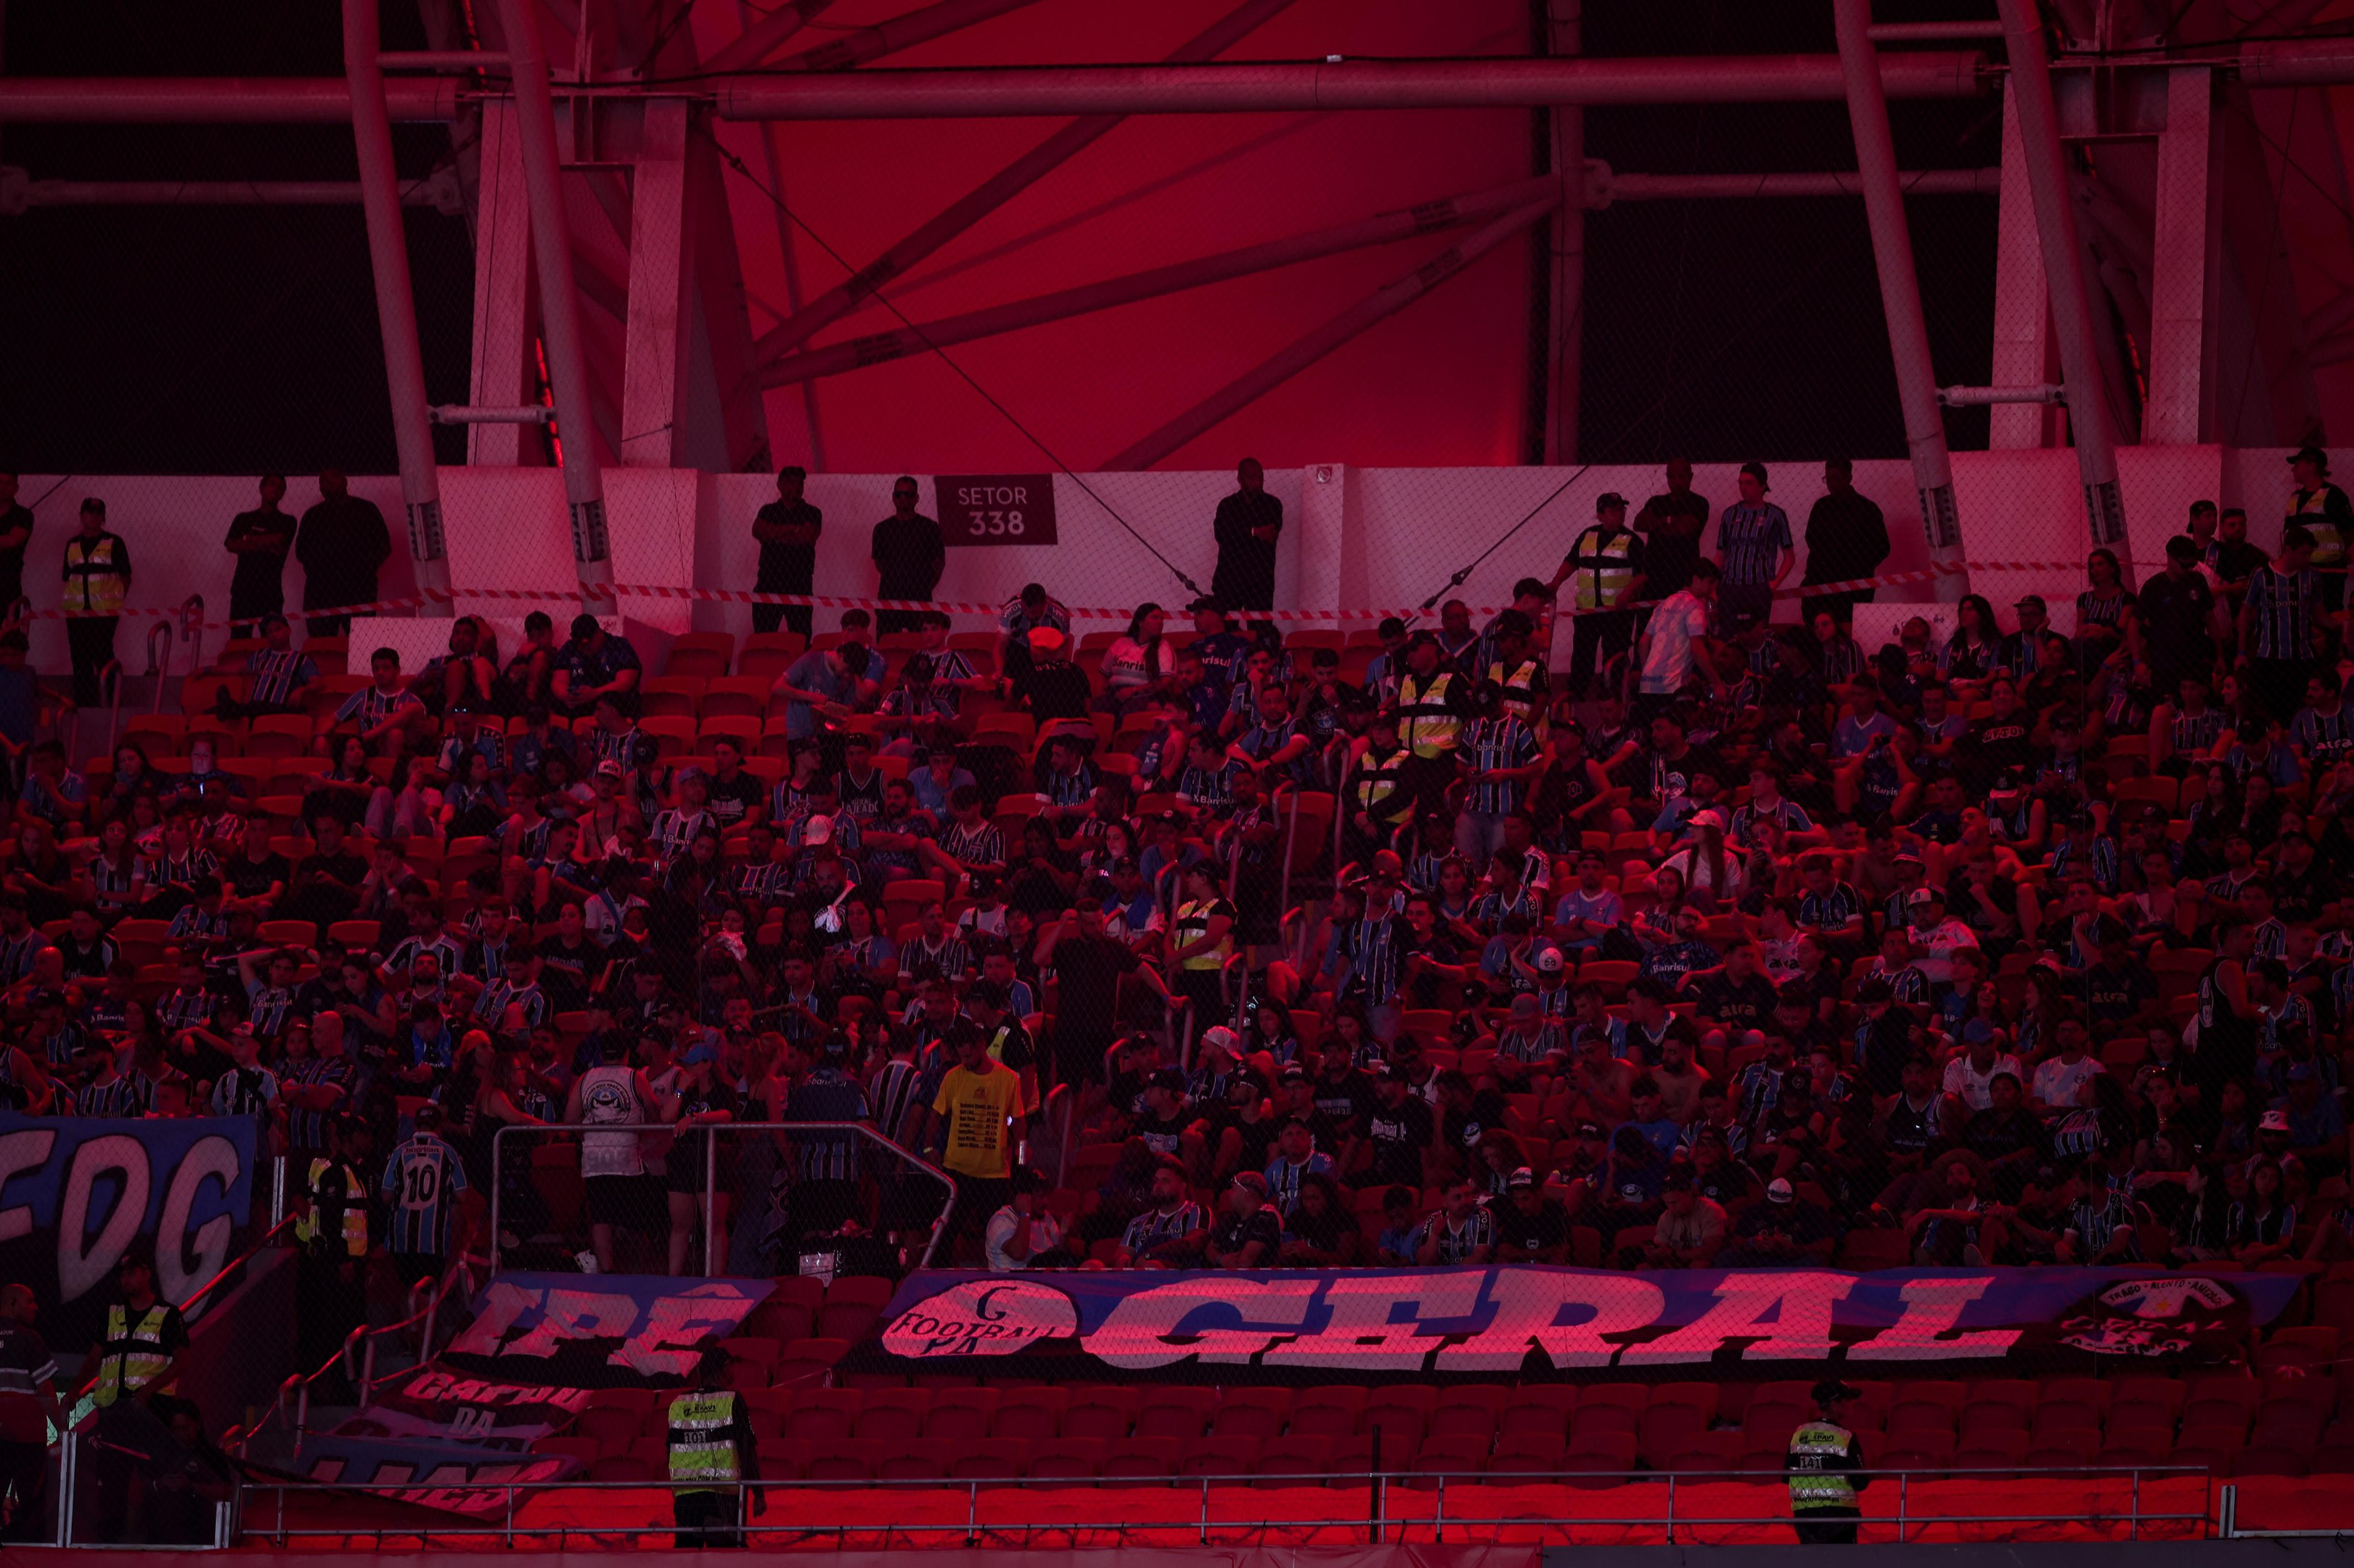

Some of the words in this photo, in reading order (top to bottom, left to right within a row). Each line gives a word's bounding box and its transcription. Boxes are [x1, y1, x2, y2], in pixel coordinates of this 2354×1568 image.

[958, 486, 1027, 505] SETOR
[969, 510, 1025, 536] 338
[1477, 743, 1506, 753] banris
[97, 1013, 125, 1024] Banris
[407, 1164, 436, 1203] 10
[976, 1285, 1018, 1321] G
[2108, 1284, 2141, 1302] TRAGO
[444, 1281, 755, 1379] IPÊ
[1079, 1267, 2024, 1371] GERAL
[447, 1406, 496, 1437] DA
[685, 1432, 705, 1444] 101
[1801, 1456, 1821, 1470] 141
